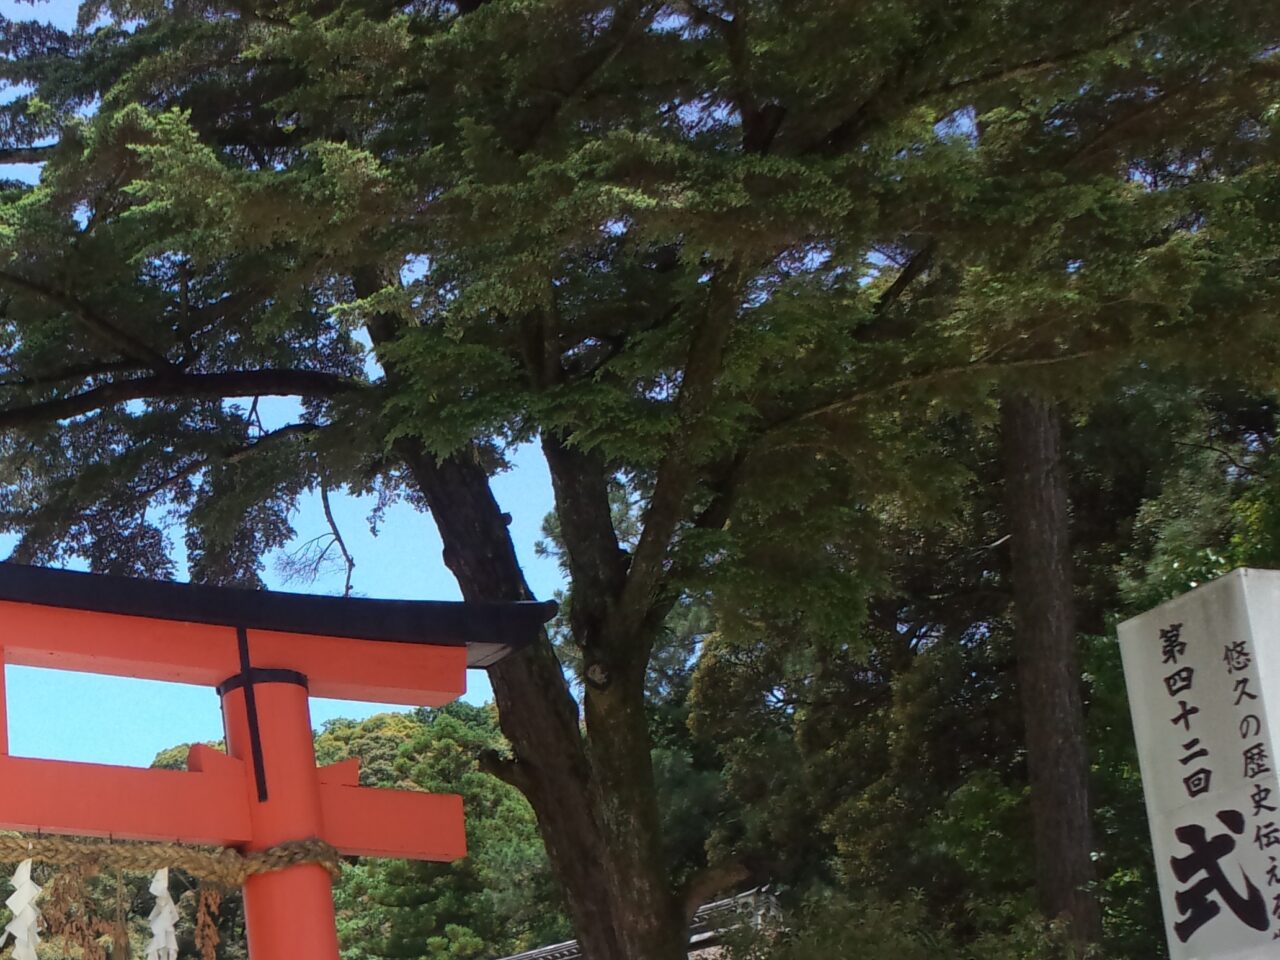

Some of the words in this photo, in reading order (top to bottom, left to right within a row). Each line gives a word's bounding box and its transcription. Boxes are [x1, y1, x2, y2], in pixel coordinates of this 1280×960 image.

[1159, 622, 1212, 798] 第四十二回
[1169, 809, 1270, 944] 式
